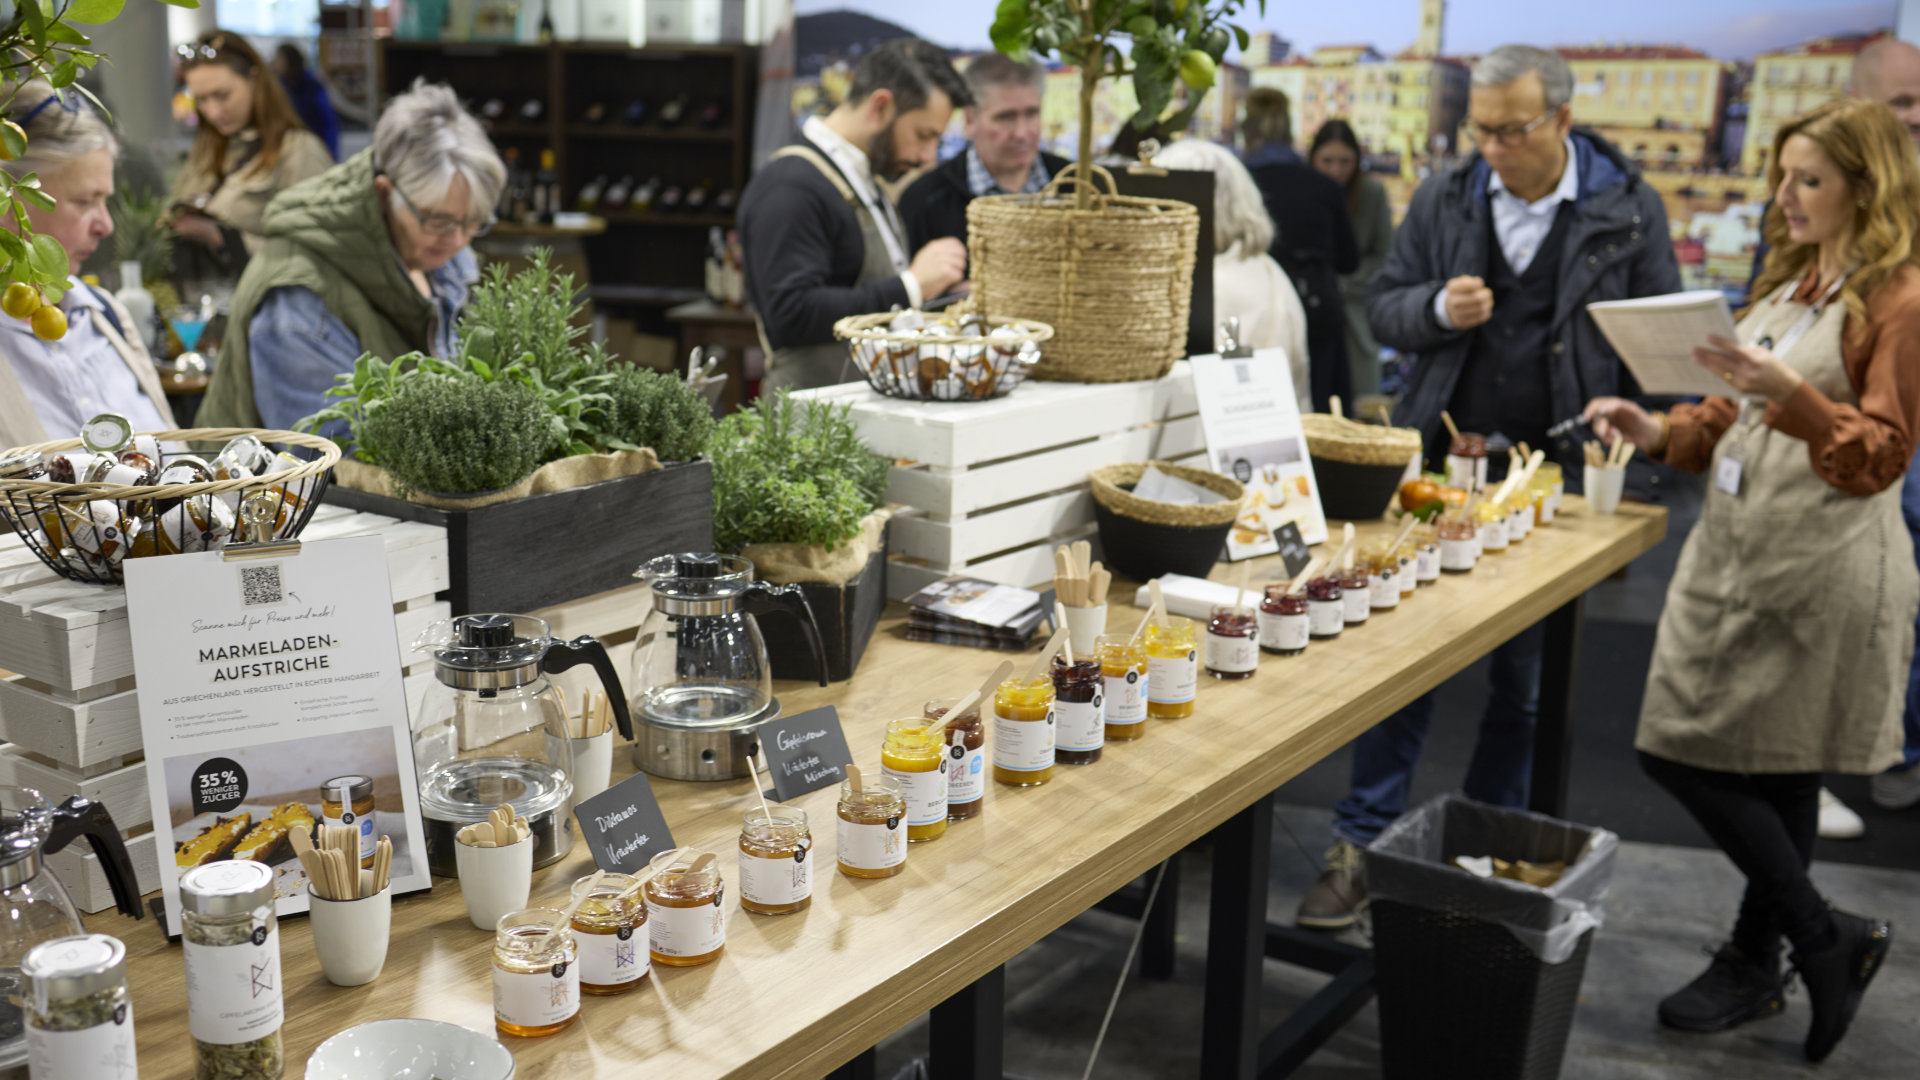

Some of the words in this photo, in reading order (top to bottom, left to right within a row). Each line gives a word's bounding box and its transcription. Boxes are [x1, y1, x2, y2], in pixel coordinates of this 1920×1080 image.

[191, 619, 224, 633] Scanne
[227, 614, 247, 627] mich
[265, 611, 292, 625] Preise
[294, 608, 312, 620] und
[199, 634, 339, 663] MARMELADEN-
[213, 655, 330, 682] AUFSTRICHE
[162, 697, 179, 706] AUS
[180, 689, 242, 703] GRIECHENLAND,
[243, 682, 294, 695] HERGESTELLT
[304, 678, 333, 687] ECHTER
[334, 671, 380, 682] HANDARBEIT
[199, 772, 220, 788] 35
[221, 770, 239, 785] %
[200, 784, 240, 796] WENIGER
[201, 791, 241, 804] ZUCKER
[594, 803, 638, 833] Diktamos
